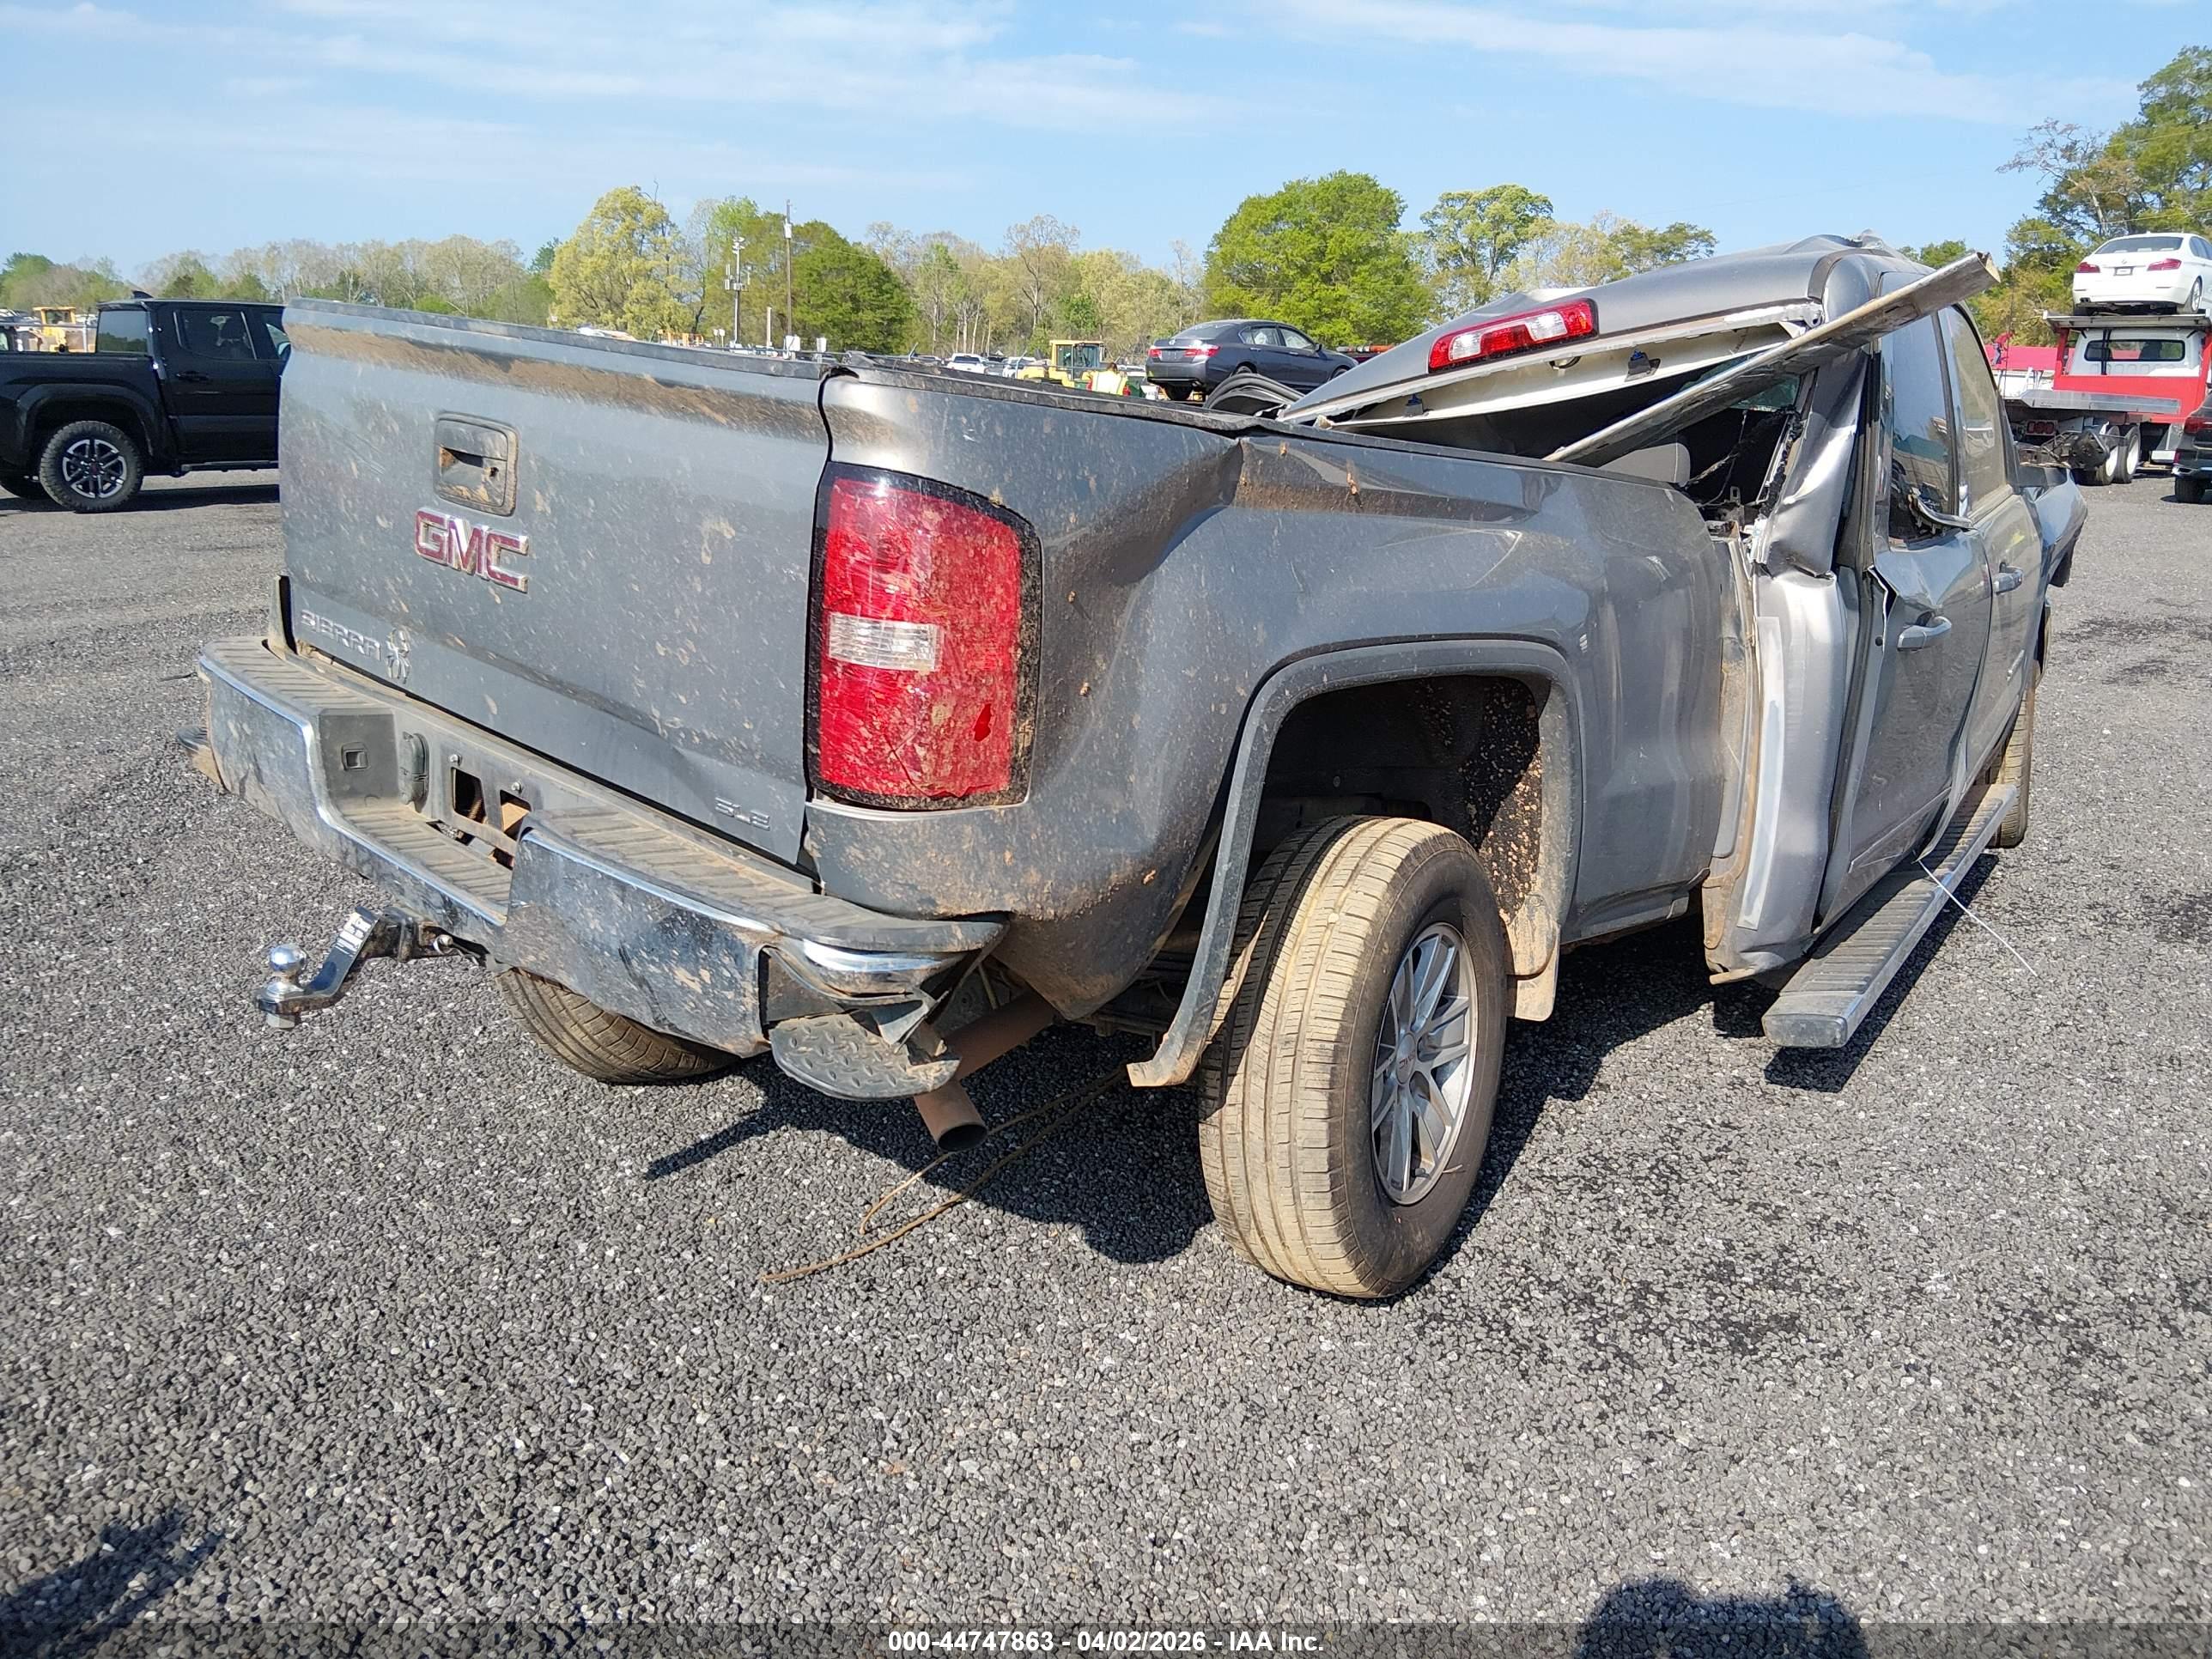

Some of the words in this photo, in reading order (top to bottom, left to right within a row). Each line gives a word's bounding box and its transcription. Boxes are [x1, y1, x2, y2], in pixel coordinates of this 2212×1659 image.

[415, 507, 529, 594] GMC
[301, 609, 382, 661] SIERRA
[714, 795, 770, 832] SLE
